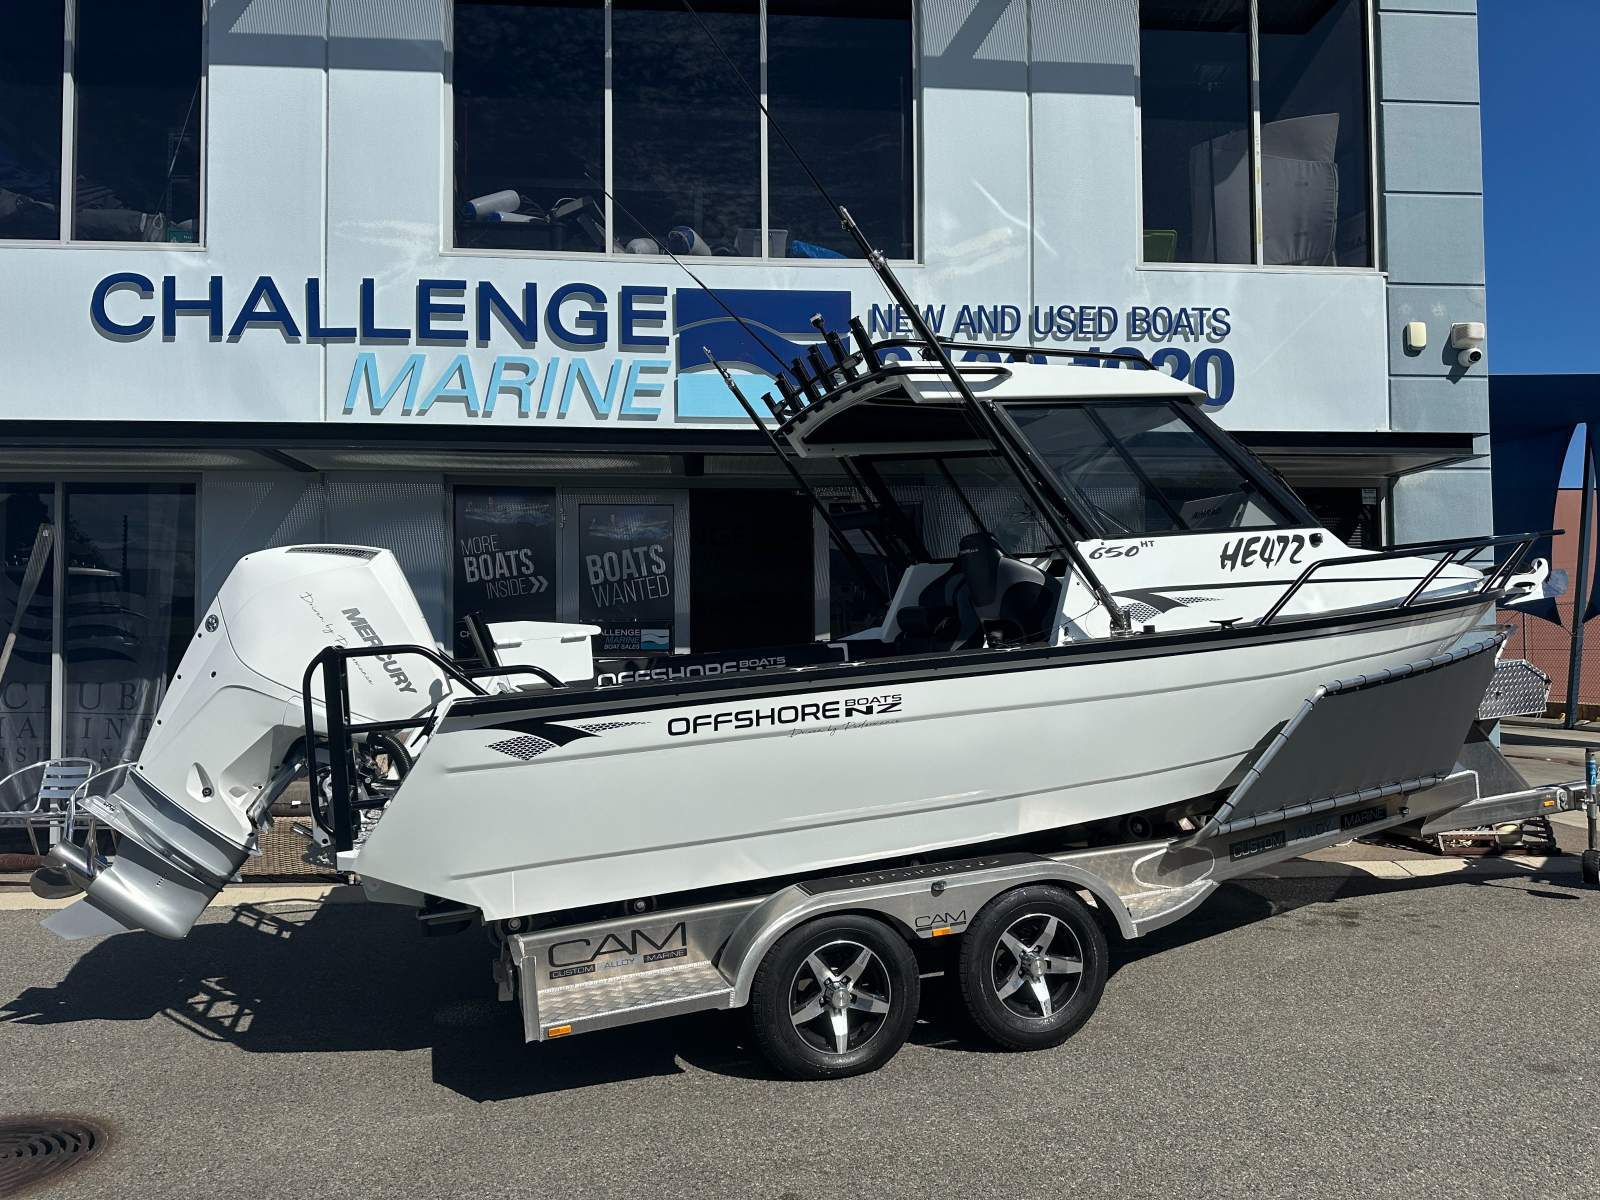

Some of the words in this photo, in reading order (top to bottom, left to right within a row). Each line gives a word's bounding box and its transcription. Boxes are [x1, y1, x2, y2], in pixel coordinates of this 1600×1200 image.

[93, 272, 669, 345] CHALLENGE
[872, 303, 946, 333] NEW
[954, 304, 1021, 334] AND
[1034, 305, 1119, 336] USED
[1131, 306, 1231, 337] BOATS
[345, 352, 671, 416] MARINE
[460, 534, 498, 555] MORE
[1088, 545, 1141, 560] 650
[1140, 540, 1155, 549] HT
[1220, 534, 1305, 572] HE472
[463, 548, 535, 583] BOATS
[585, 544, 667, 585] BOATS
[486, 577, 530, 600] INSIDE
[592, 575, 670, 609] WANTED
[739, 655, 786, 668] BOATS
[667, 700, 840, 737] OFFSHORE
[844, 693, 903, 707] BOATS
[844, 702, 903, 718] NZ
[1344, 808, 1385, 827] MARINE
[914, 910, 967, 928] CAM
[548, 921, 687, 967] CAM
[552, 965, 595, 978] CUSTOM
[603, 957, 636, 969] ALLOY
[646, 949, 686, 962] MARINE
